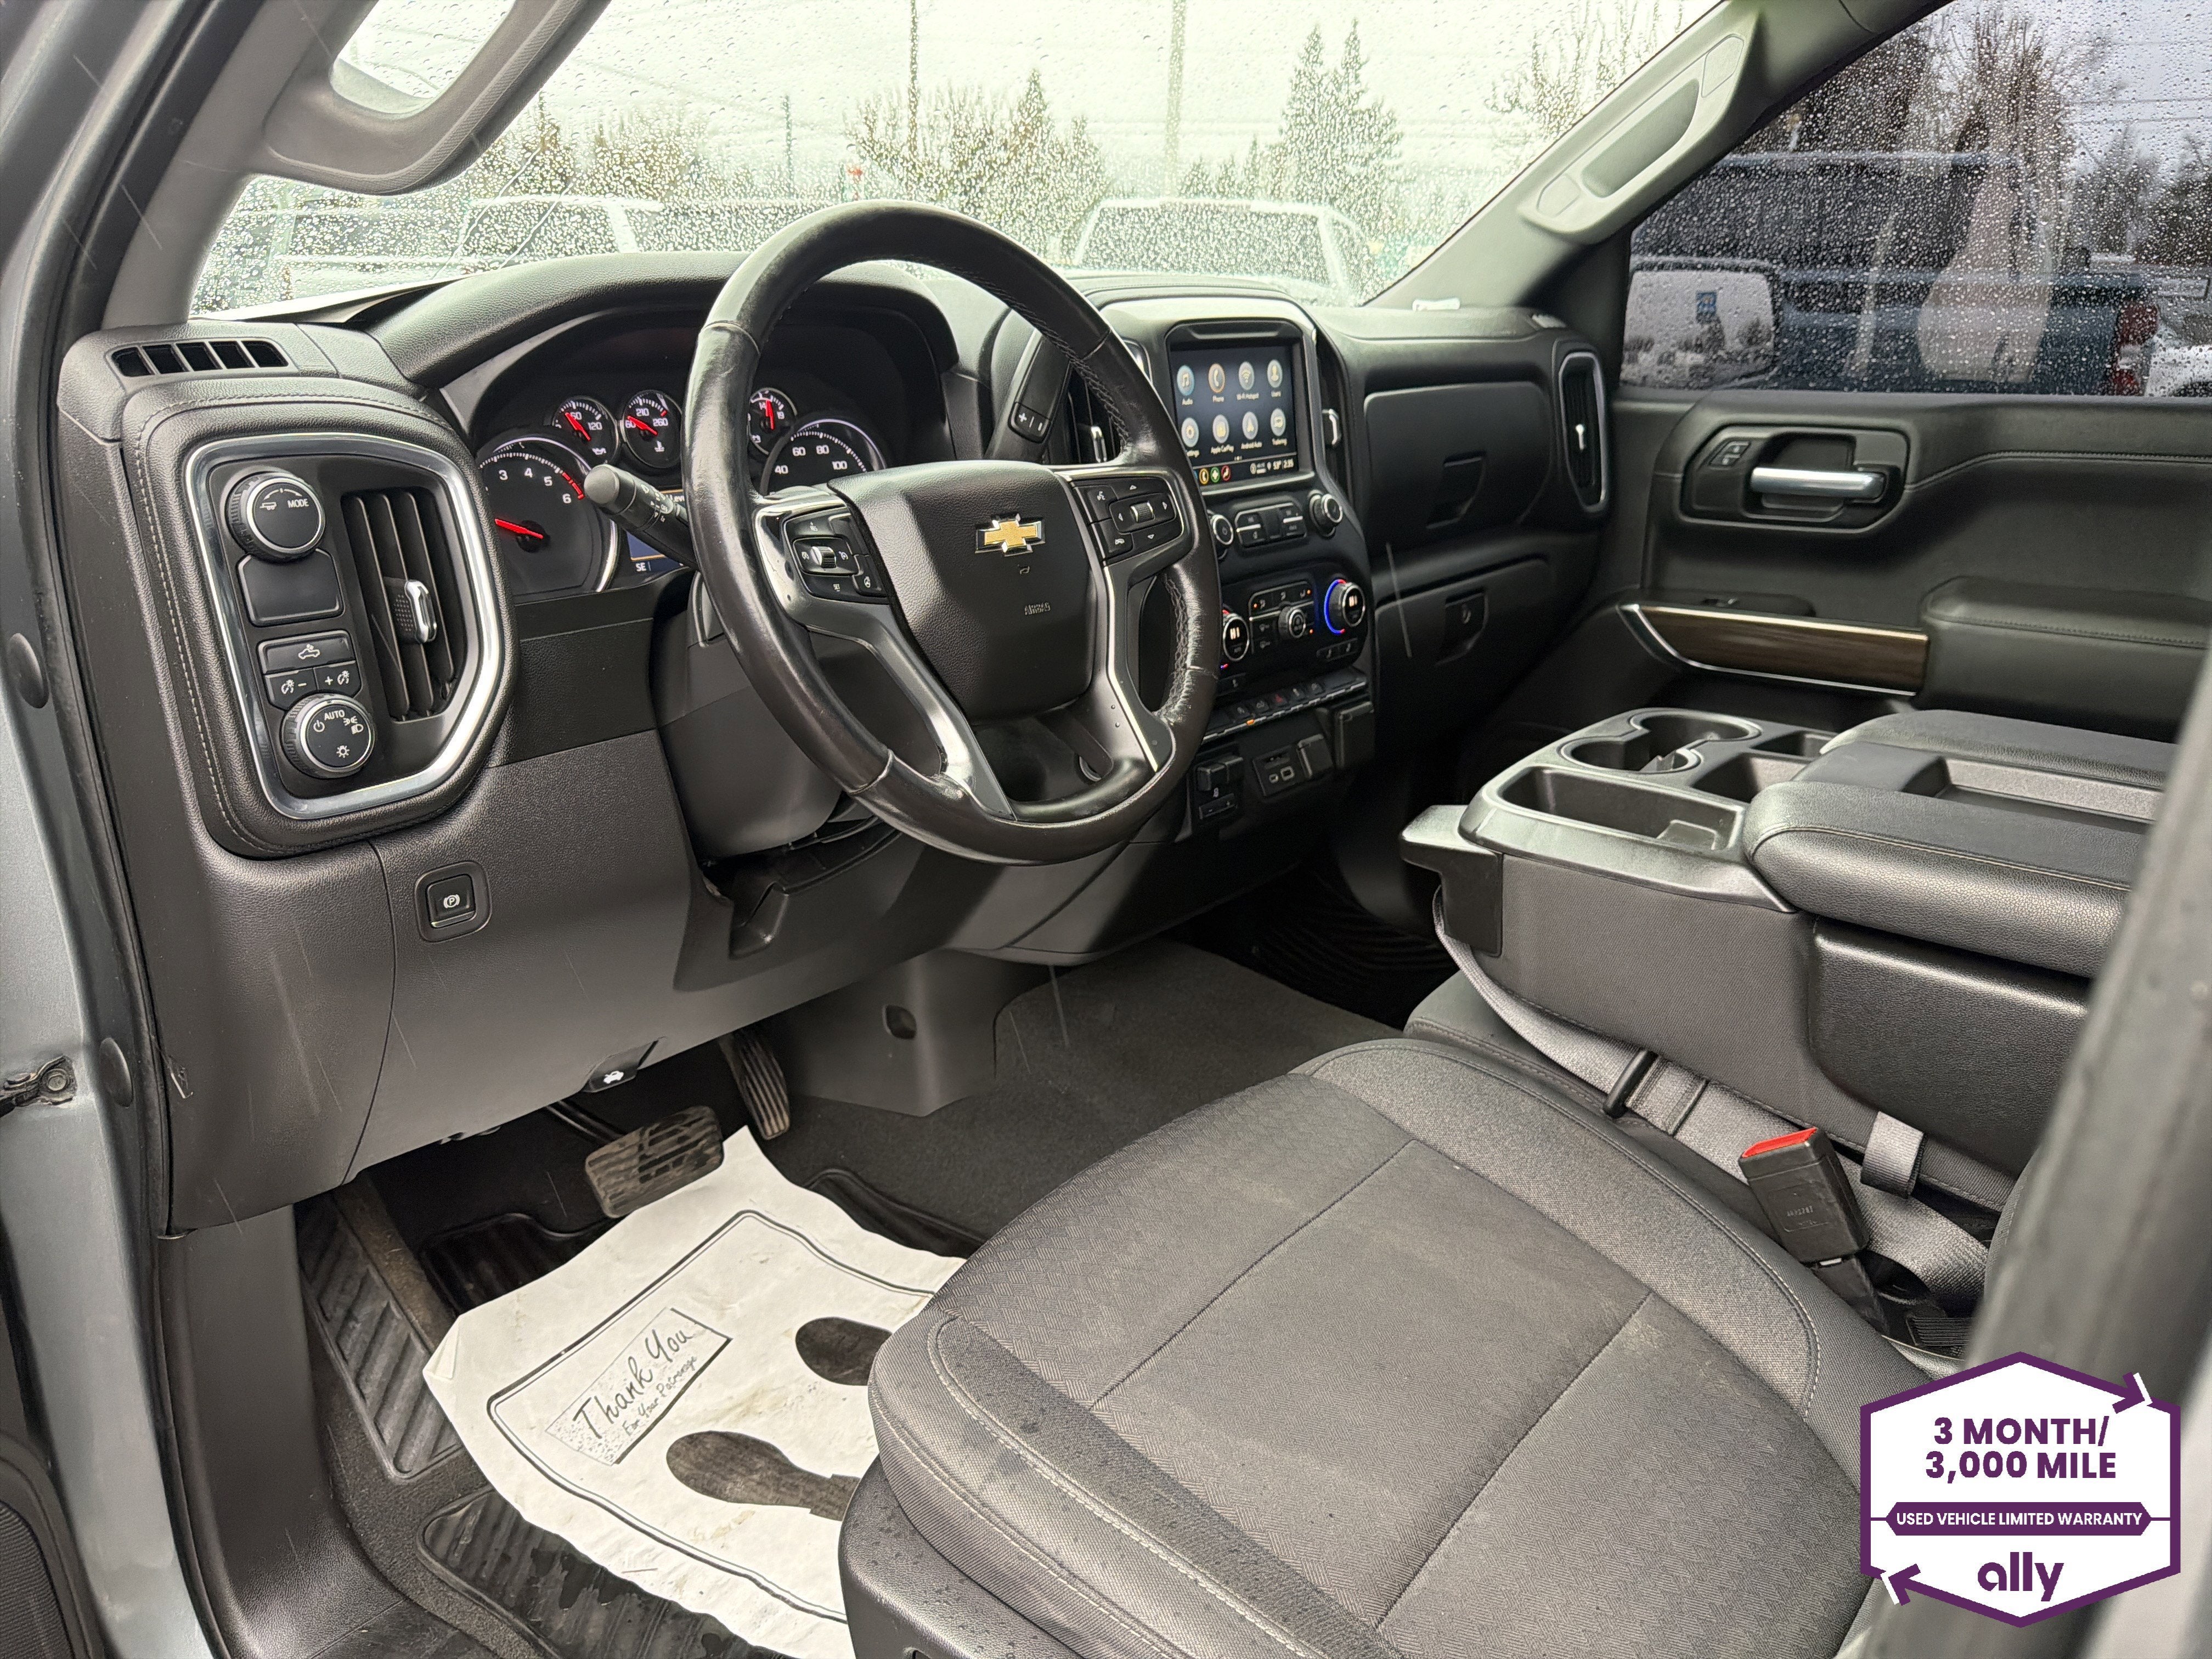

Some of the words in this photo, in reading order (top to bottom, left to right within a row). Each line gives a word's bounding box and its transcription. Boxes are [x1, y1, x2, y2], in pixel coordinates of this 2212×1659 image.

[635, 408, 650, 416] 210
[588, 421, 602, 431] 120
[653, 417, 668, 427] 260
[792, 447, 806, 456] 60
[816, 444, 830, 455] 80
[774, 465, 788, 475] 40
[832, 460, 848, 470] 100
[499, 470, 508, 481] 3
[524, 467, 533, 478] 4
[544, 476, 552, 486] 5
[287, 498, 309, 508] MODE
[562, 493, 572, 504] 6
[636, 562, 647, 572] SE
[1024, 602, 1051, 616] AIRBAG
[324, 709, 345, 721] AUTO
[572, 1356, 653, 1439] Thank
[645, 1329, 694, 1363] You
[622, 1419, 640, 1436] For
[638, 1398, 659, 1418] Your
